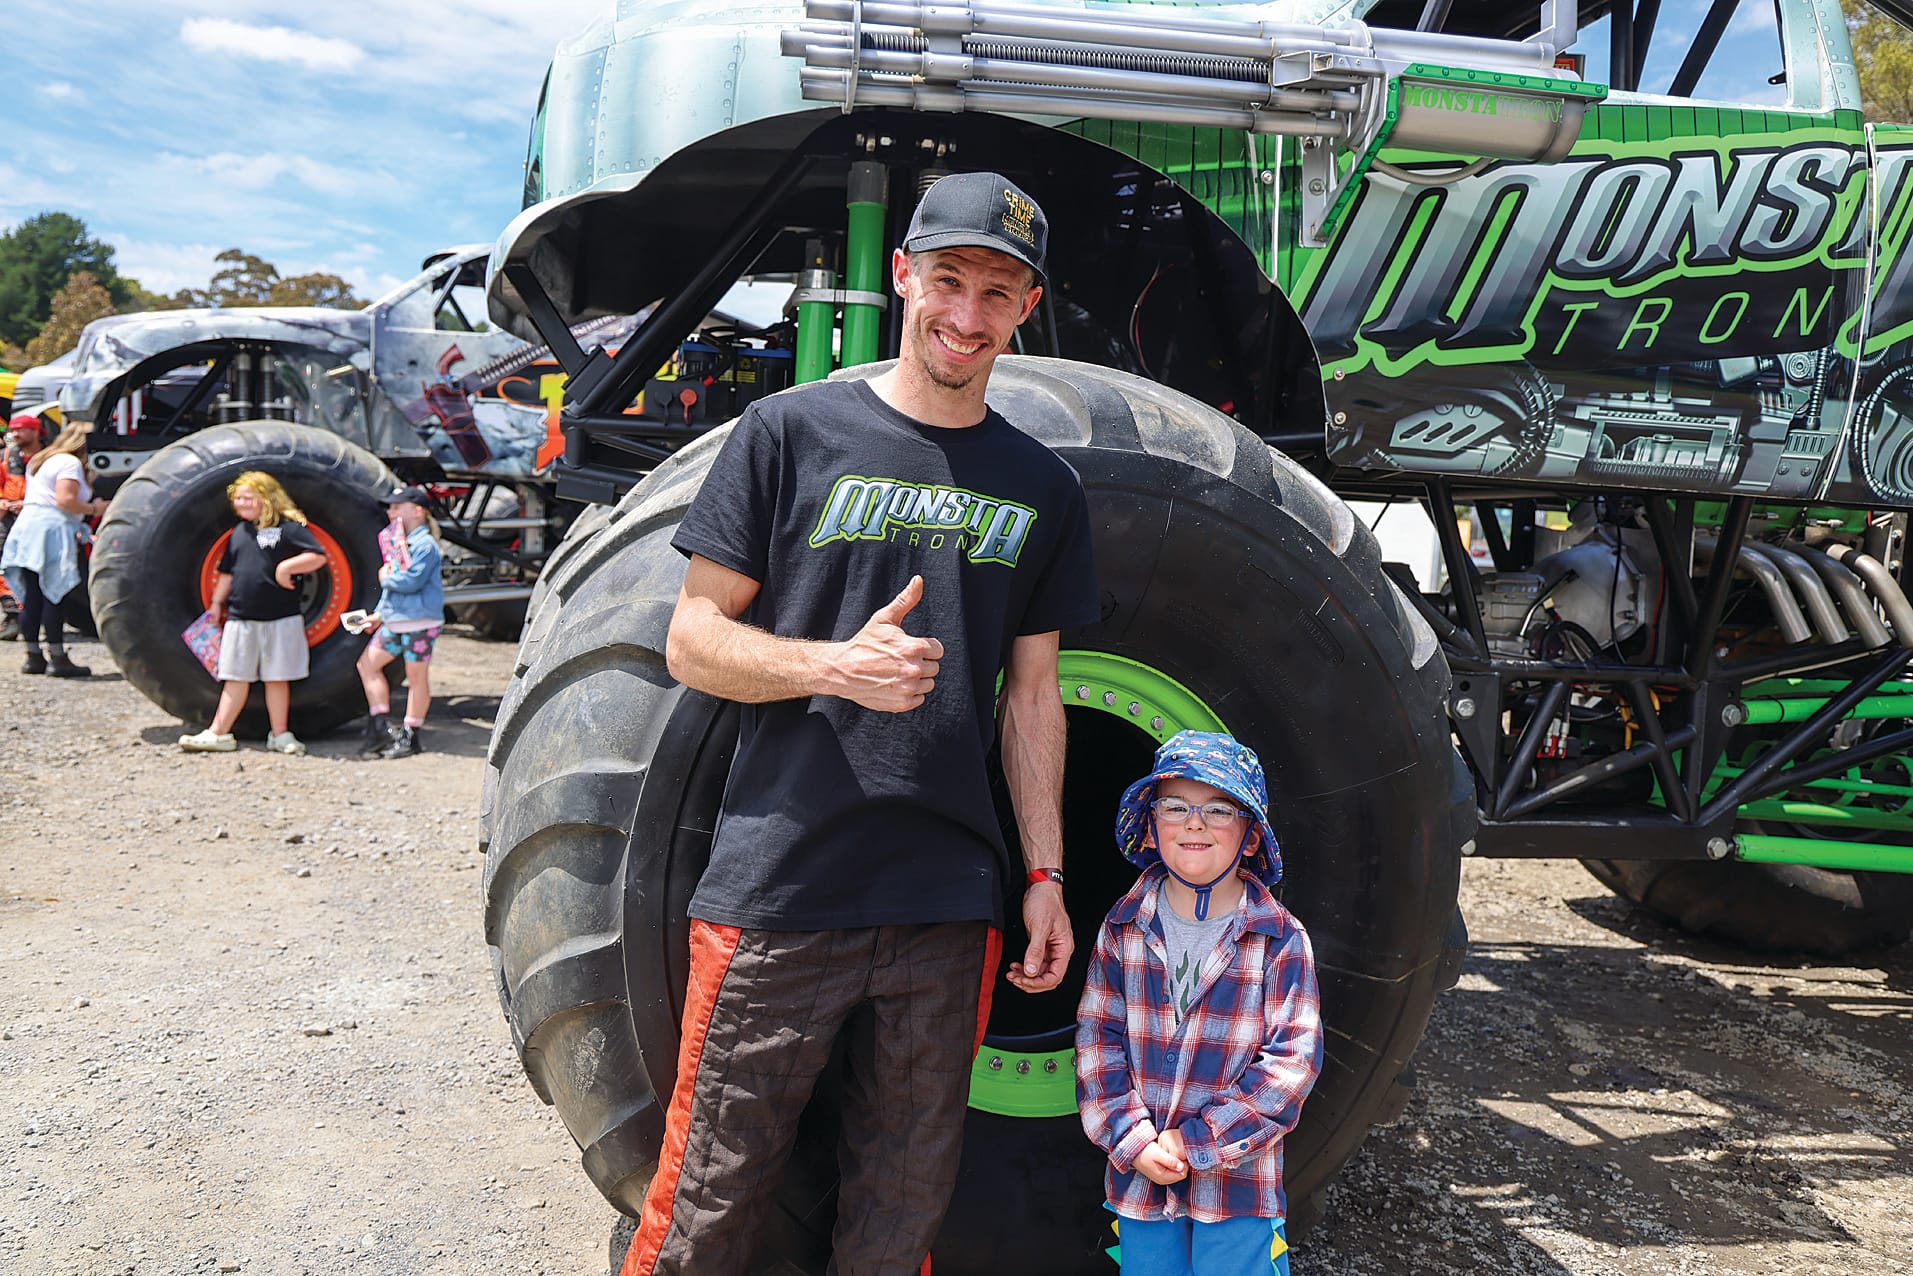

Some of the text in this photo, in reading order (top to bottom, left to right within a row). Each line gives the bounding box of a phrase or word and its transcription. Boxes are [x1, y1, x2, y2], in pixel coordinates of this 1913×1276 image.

[1003, 189, 1035, 219] CRIME
[1008, 202, 1032, 228] TIME
[1300, 145, 1913, 356] MONST
[1553, 285, 1835, 355] TRON
[810, 476, 1037, 566] MONSTA
[889, 527, 969, 551] TRON
